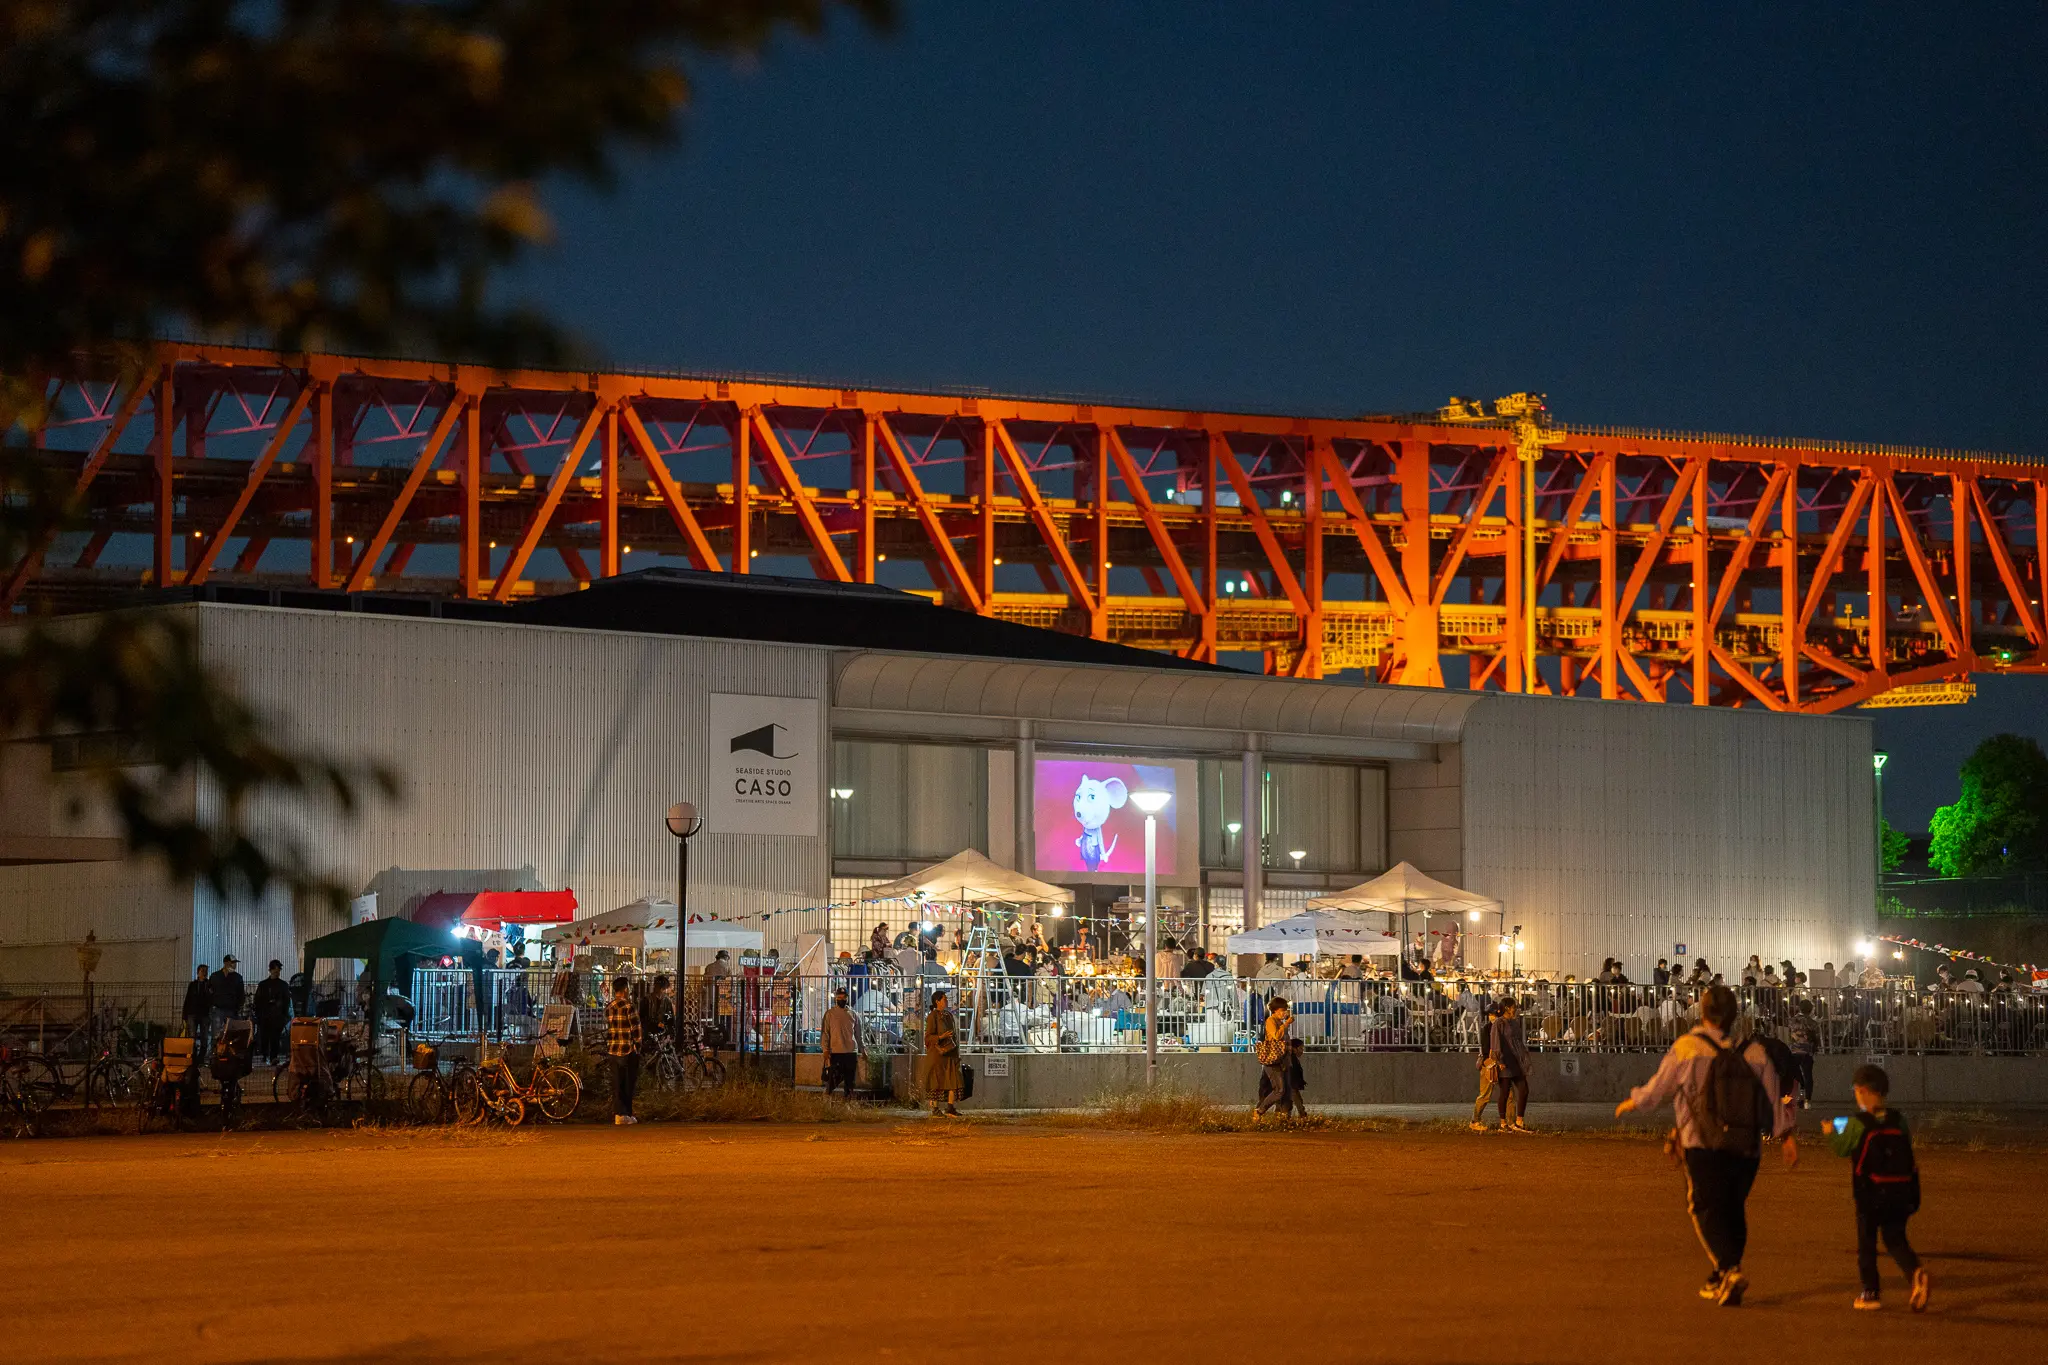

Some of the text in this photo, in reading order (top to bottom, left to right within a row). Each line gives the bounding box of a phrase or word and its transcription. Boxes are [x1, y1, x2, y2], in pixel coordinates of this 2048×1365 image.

[735, 778, 791, 797] CASO
[740, 957, 775, 966] NEWLY PICED
